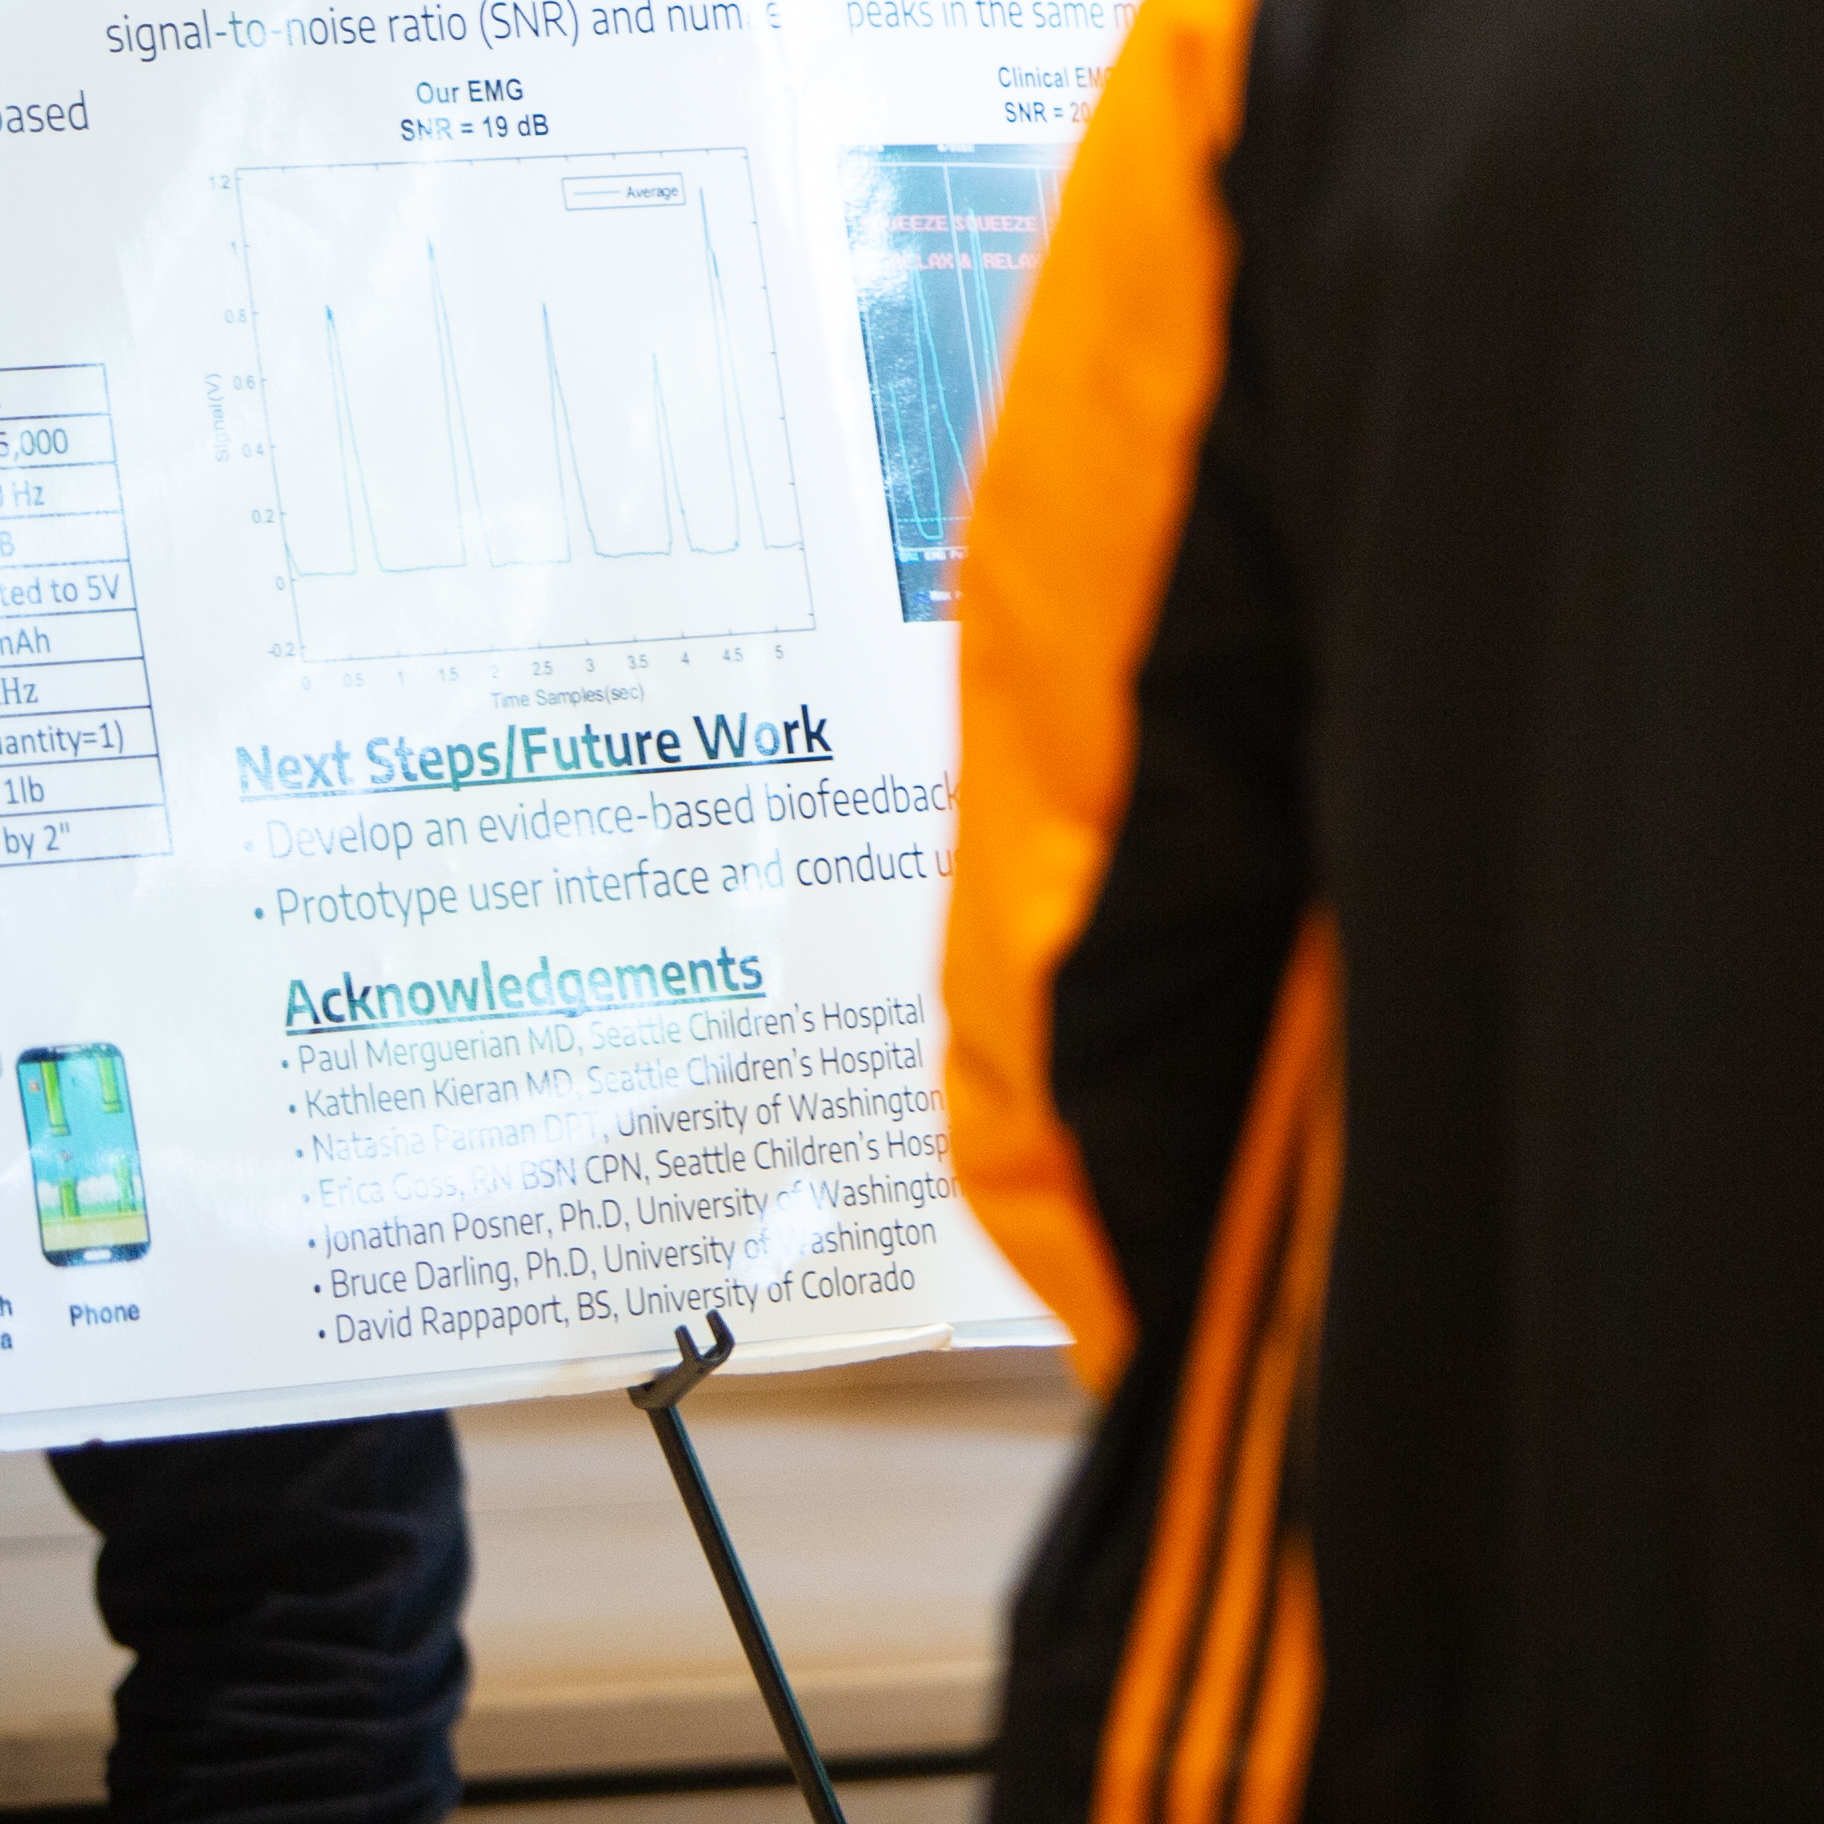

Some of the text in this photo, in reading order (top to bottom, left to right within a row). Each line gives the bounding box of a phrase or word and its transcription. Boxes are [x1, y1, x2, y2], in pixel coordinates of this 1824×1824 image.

[107, 7, 377, 61] signal-to-noise
[388, 4, 467, 43] ratio
[1032, 0, 1105, 29] same
[998, 66, 1070, 88] Clinical
[416, 79, 524, 106] Our EMG
[0, 89, 89, 134] ased
[1005, 101, 1048, 123] SNR
[401, 113, 549, 143] SNR = 19 dB
[626, 184, 679, 201] Average
[225, 309, 247, 324] 0.8
[233, 375, 256, 391] 0.6
[243, 442, 264, 458] 0.4
[252, 508, 275, 524] 0.2
[51, 578, 78, 603] to
[87, 573, 119, 601] 5V
[586, 657, 595, 672] 3
[627, 654, 649, 670] 3.5
[680, 651, 690, 666] 4
[722, 647, 743, 663] 4.5
[775, 644, 784, 659] 5
[532, 660, 554, 676] 2.5
[491, 683, 645, 709] Time Samples(sec)
[236, 703, 833, 794] Next Steps/Future Work
[4, 775, 45, 805] 1lb
[267, 771, 959, 860] Develop an evidence-based biofeedback
[4, 827, 34, 860] by
[277, 881, 458, 927] Prototype
[469, 878, 547, 912] user
[552, 858, 709, 906] interface
[722, 847, 785, 893] and
[797, 842, 928, 887] conduct
[285, 945, 764, 1027] Acknowledgements
[297, 1038, 358, 1074] Paul
[365, 1029, 520, 1072] Merguerian
[528, 1023, 584, 1057] MD,
[590, 1013, 681, 1051] Seattle
[821, 994, 926, 1035] Hospital
[305, 1082, 426, 1120] Kathleen
[433, 1077, 519, 1109] Kieran
[586, 1058, 679, 1095] Seattle
[819, 1038, 923, 1080] Hospital
[616, 1099, 748, 1138] University
[756, 1092, 782, 1126] of
[787, 1086, 946, 1123] Washington
[319, 1176, 385, 1210] Erica
[520, 1157, 577, 1192] BSN
[585, 1152, 650, 1186] CPN,
[657, 1142, 746, 1179] Seattle
[886, 1129, 949, 1164] Hosp
[325, 1216, 444, 1260] Jonathan
[452, 1209, 553, 1241] Posner,
[560, 1199, 631, 1232] Ph.D,
[637, 1184, 768, 1223] University
[331, 1268, 407, 1299] Bruce
[415, 1255, 519, 1293] Darling,
[526, 1245, 597, 1280] Ph.D,
[604, 1232, 735, 1272] University
[70, 1302, 141, 1326] Phone
[336, 1260, 916, 1344] David Rappaport, BS, University of Colorado
